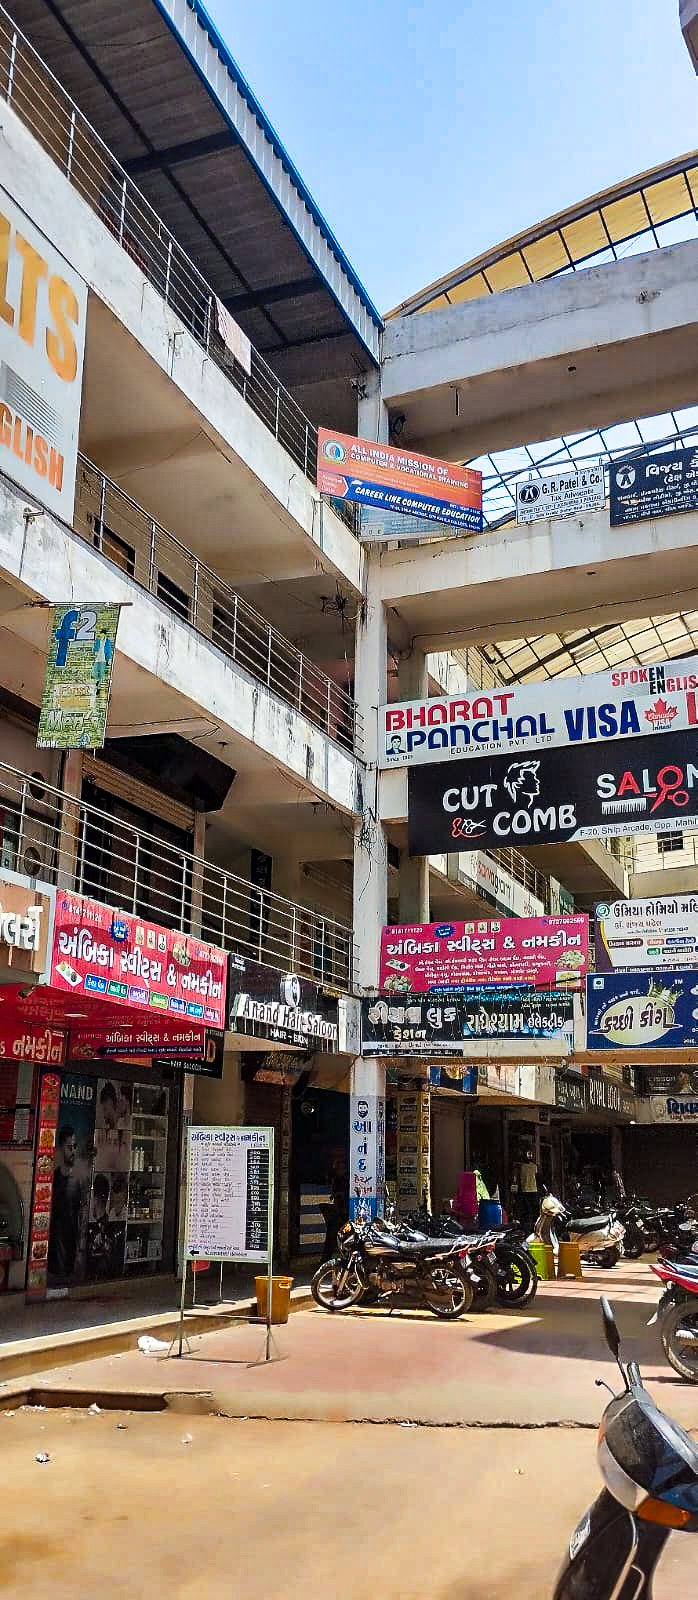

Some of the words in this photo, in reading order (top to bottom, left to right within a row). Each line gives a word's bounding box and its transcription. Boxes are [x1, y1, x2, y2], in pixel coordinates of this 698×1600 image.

[370, 449, 394, 462] INDIA
[398, 456, 434, 473] MISSION
[645, 461, 683, 478] વિજય
[581, 475, 587, 486] &
[355, 486, 384, 500] CAREER
[385, 494, 401, 504] LINE
[402, 498, 440, 514] COMPUTER
[442, 508, 481, 523] EDUCATION
[611, 666, 665, 687] SPOKEN
[385, 693, 515, 732] BHARAT
[563, 699, 641, 742] VISA
[406, 712, 555, 752] PANCHAL
[442, 784, 498, 812] CUT
[492, 803, 577, 836] COMB
[386, 938, 440, 955] અંબિકા
[503, 935, 516, 950] &
[521, 929, 582, 948] નમકીન
[58, 927, 115, 969] અંબિકા
[166, 962, 178, 988] &
[182, 969, 223, 1000] નમકીન
